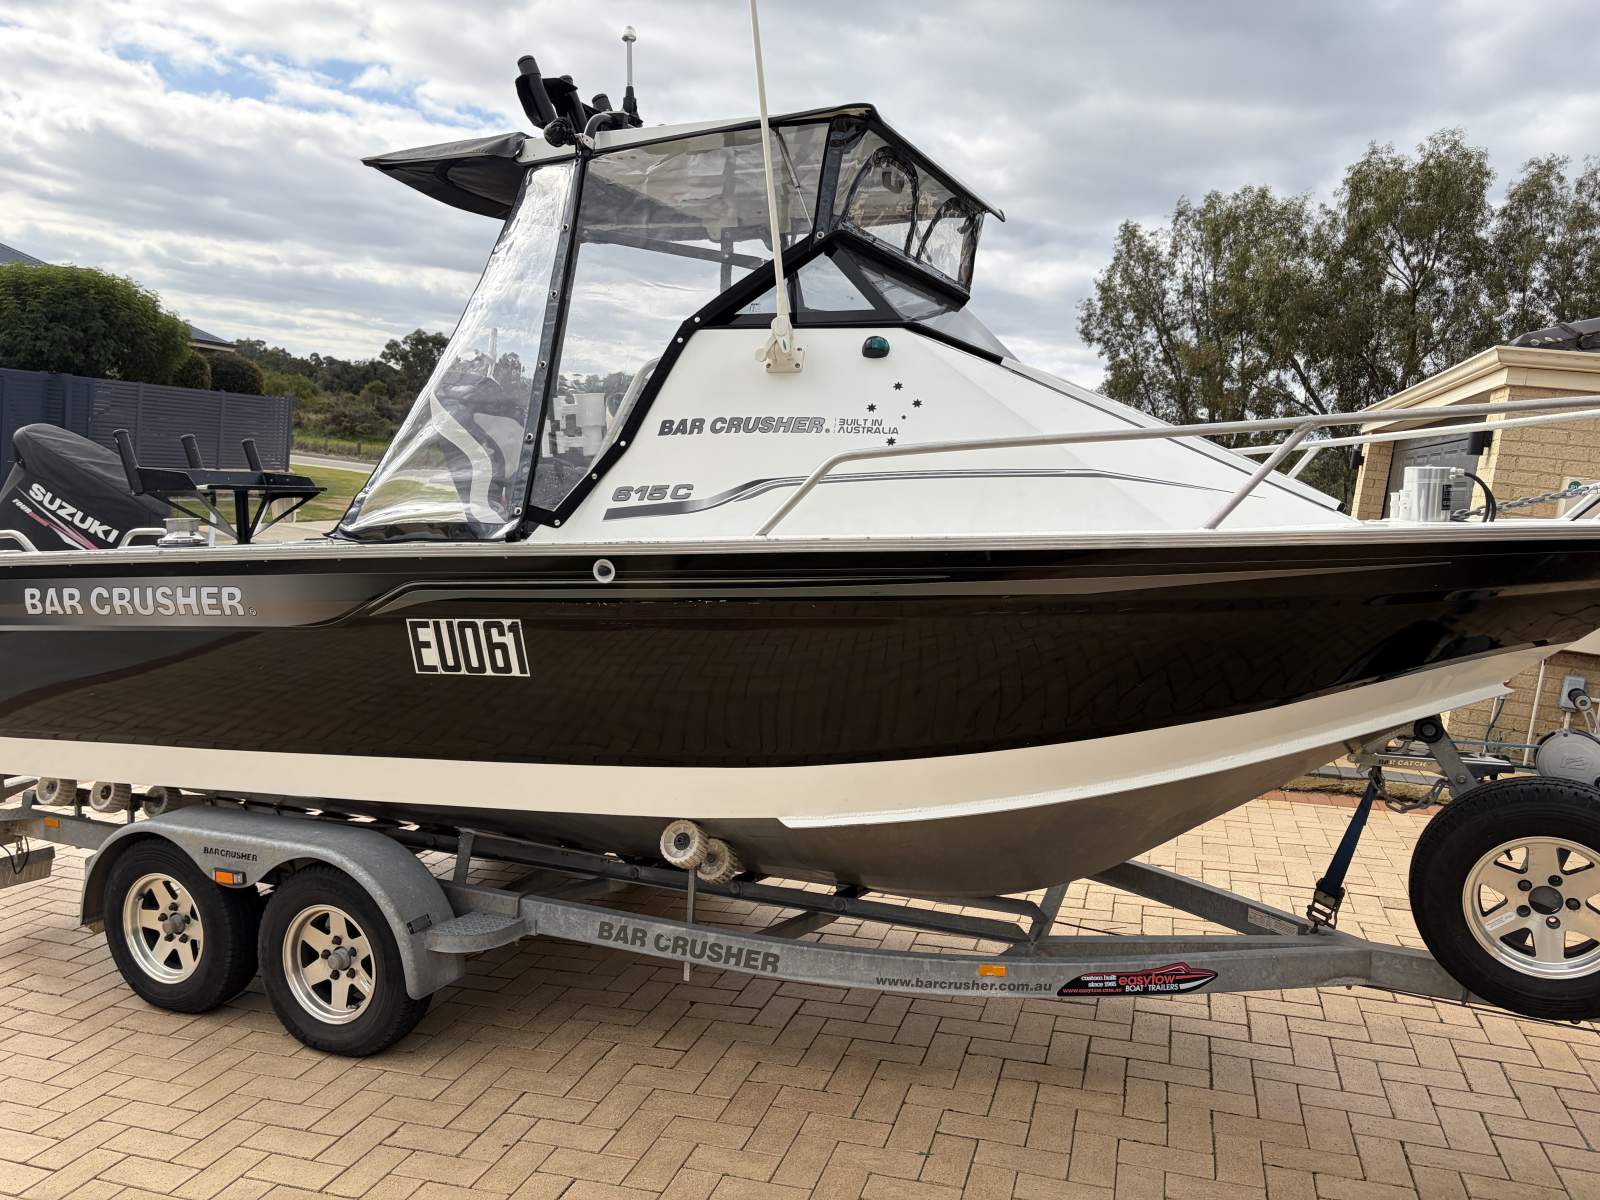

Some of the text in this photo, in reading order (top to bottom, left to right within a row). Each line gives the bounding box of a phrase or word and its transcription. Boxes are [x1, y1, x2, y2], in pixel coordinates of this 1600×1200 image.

[658, 416, 826, 436] BAR CRUSHER
[837, 426, 899, 435] AUSTRALIA
[838, 418, 883, 427] BUILT IN
[29, 483, 119, 543] SUZUKI
[24, 587, 245, 616] BAR CRUSHER
[406, 618, 530, 677] EU061
[203, 846, 258, 862] BARCRUSHER
[597, 921, 781, 973] BAR CRUSHER
[875, 975, 1053, 993] www.barcrusher.com.au
[1125, 983, 1179, 992] BOAT TRAILERS
